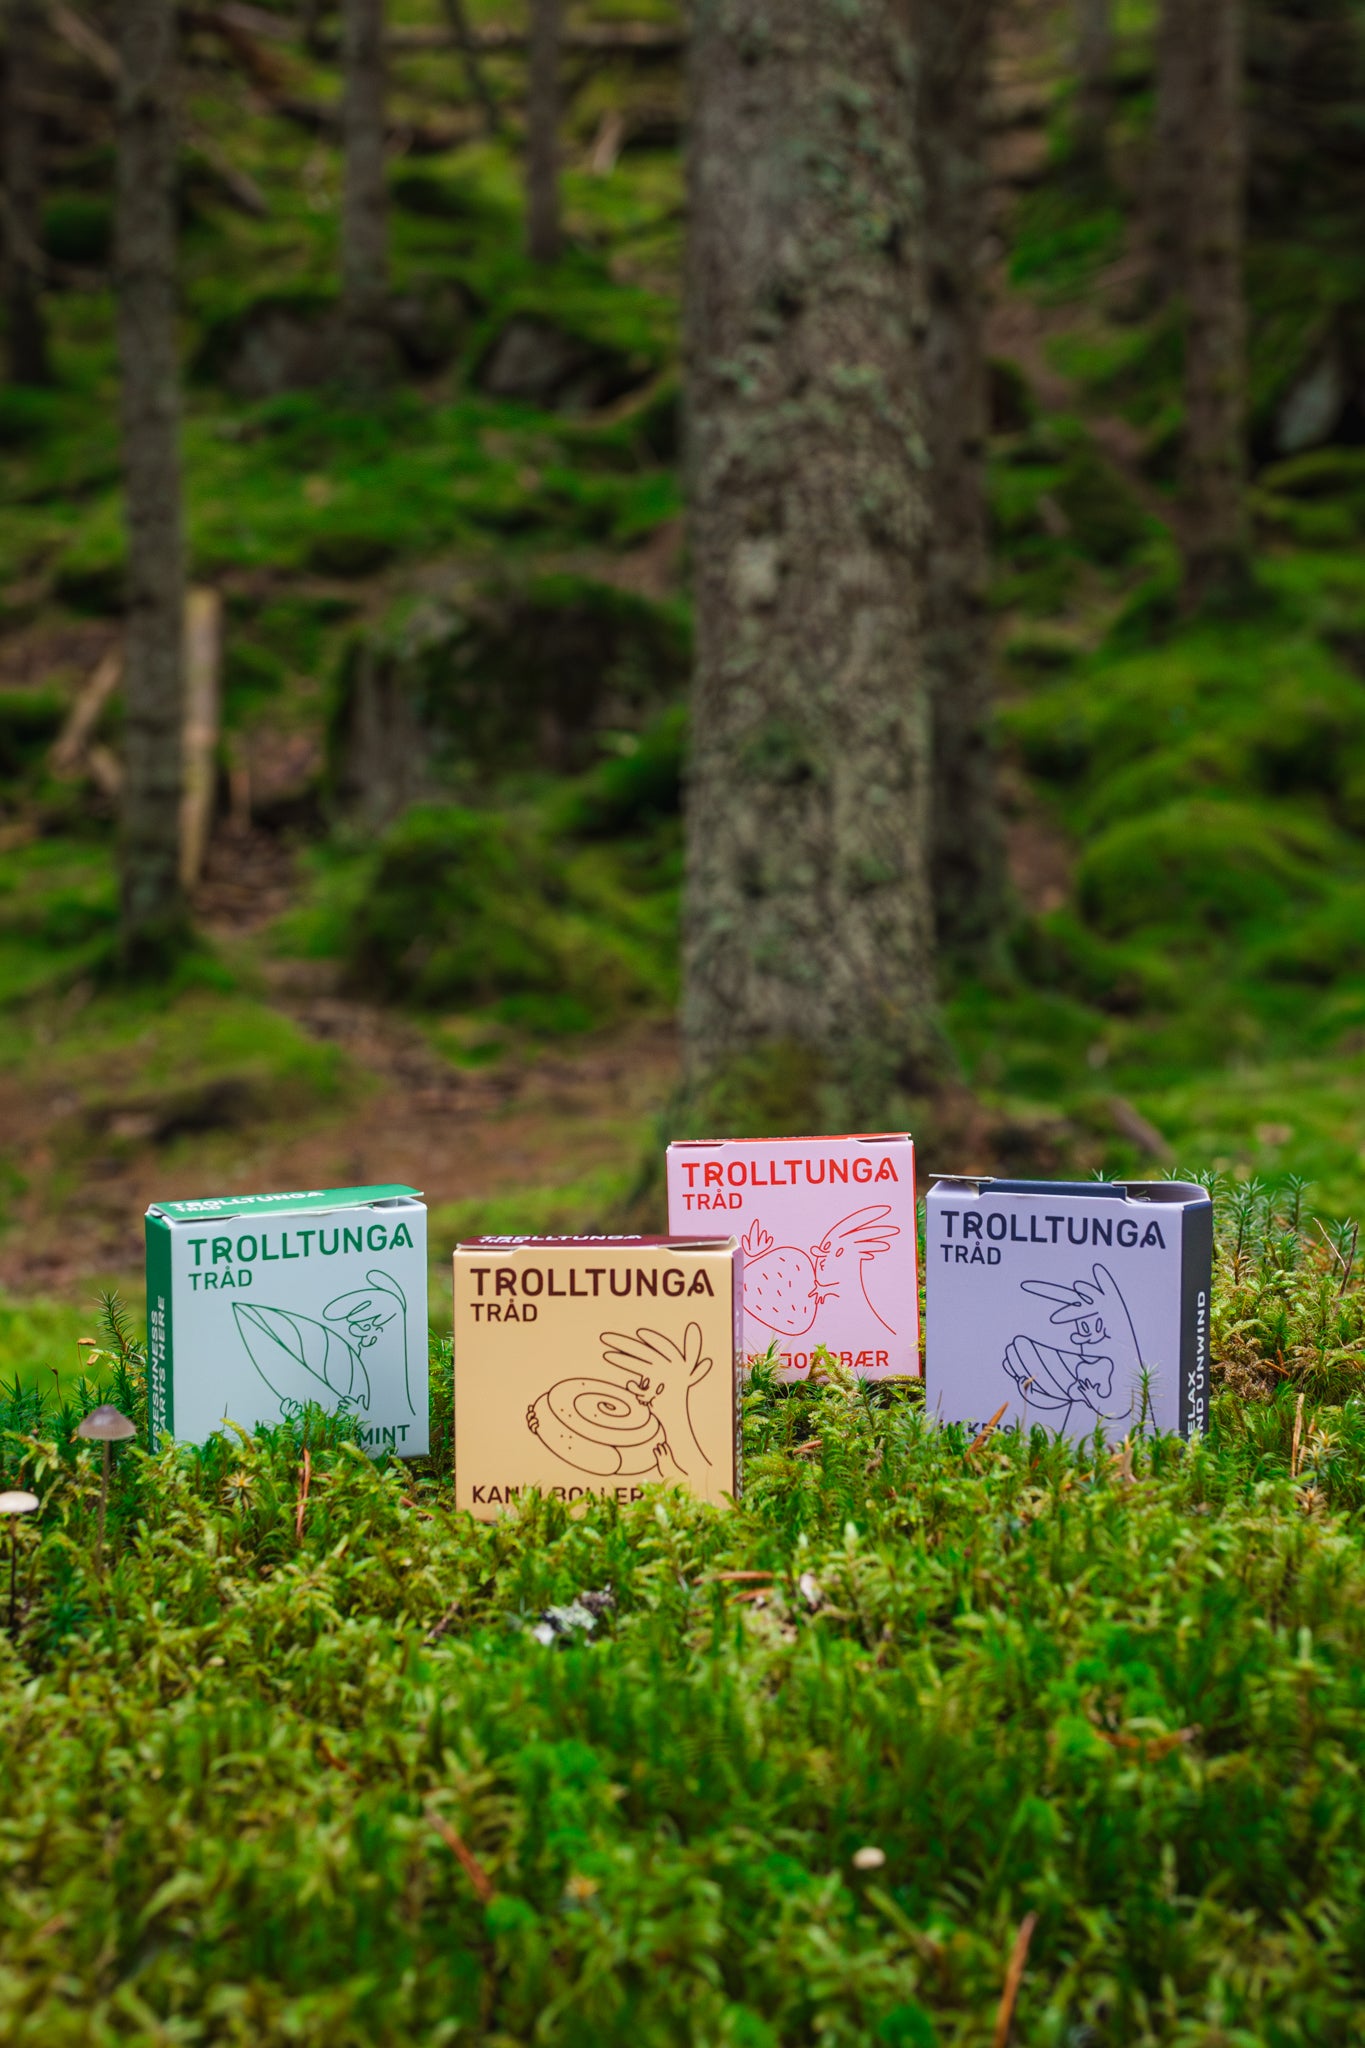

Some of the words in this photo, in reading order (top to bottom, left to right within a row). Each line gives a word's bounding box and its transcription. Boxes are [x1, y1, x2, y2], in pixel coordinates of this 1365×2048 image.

[681, 1157, 899, 1187] TROLLTUNGA
[169, 1191, 325, 1208] TROLLTUNGA
[682, 1189, 743, 1211] TRÅD
[187, 1222, 414, 1266] TROLLTUNGA
[940, 1210, 1166, 1250] TROLLTUNGA
[940, 1241, 1001, 1265] TRÅD
[188, 1266, 253, 1291] TRÅD
[470, 1268, 715, 1297] TROLLTUNGA
[471, 1299, 538, 1322] TRÅD
[1197, 1291, 1206, 1390] UNWIND
[1187, 1370, 1196, 1444] ELAX
